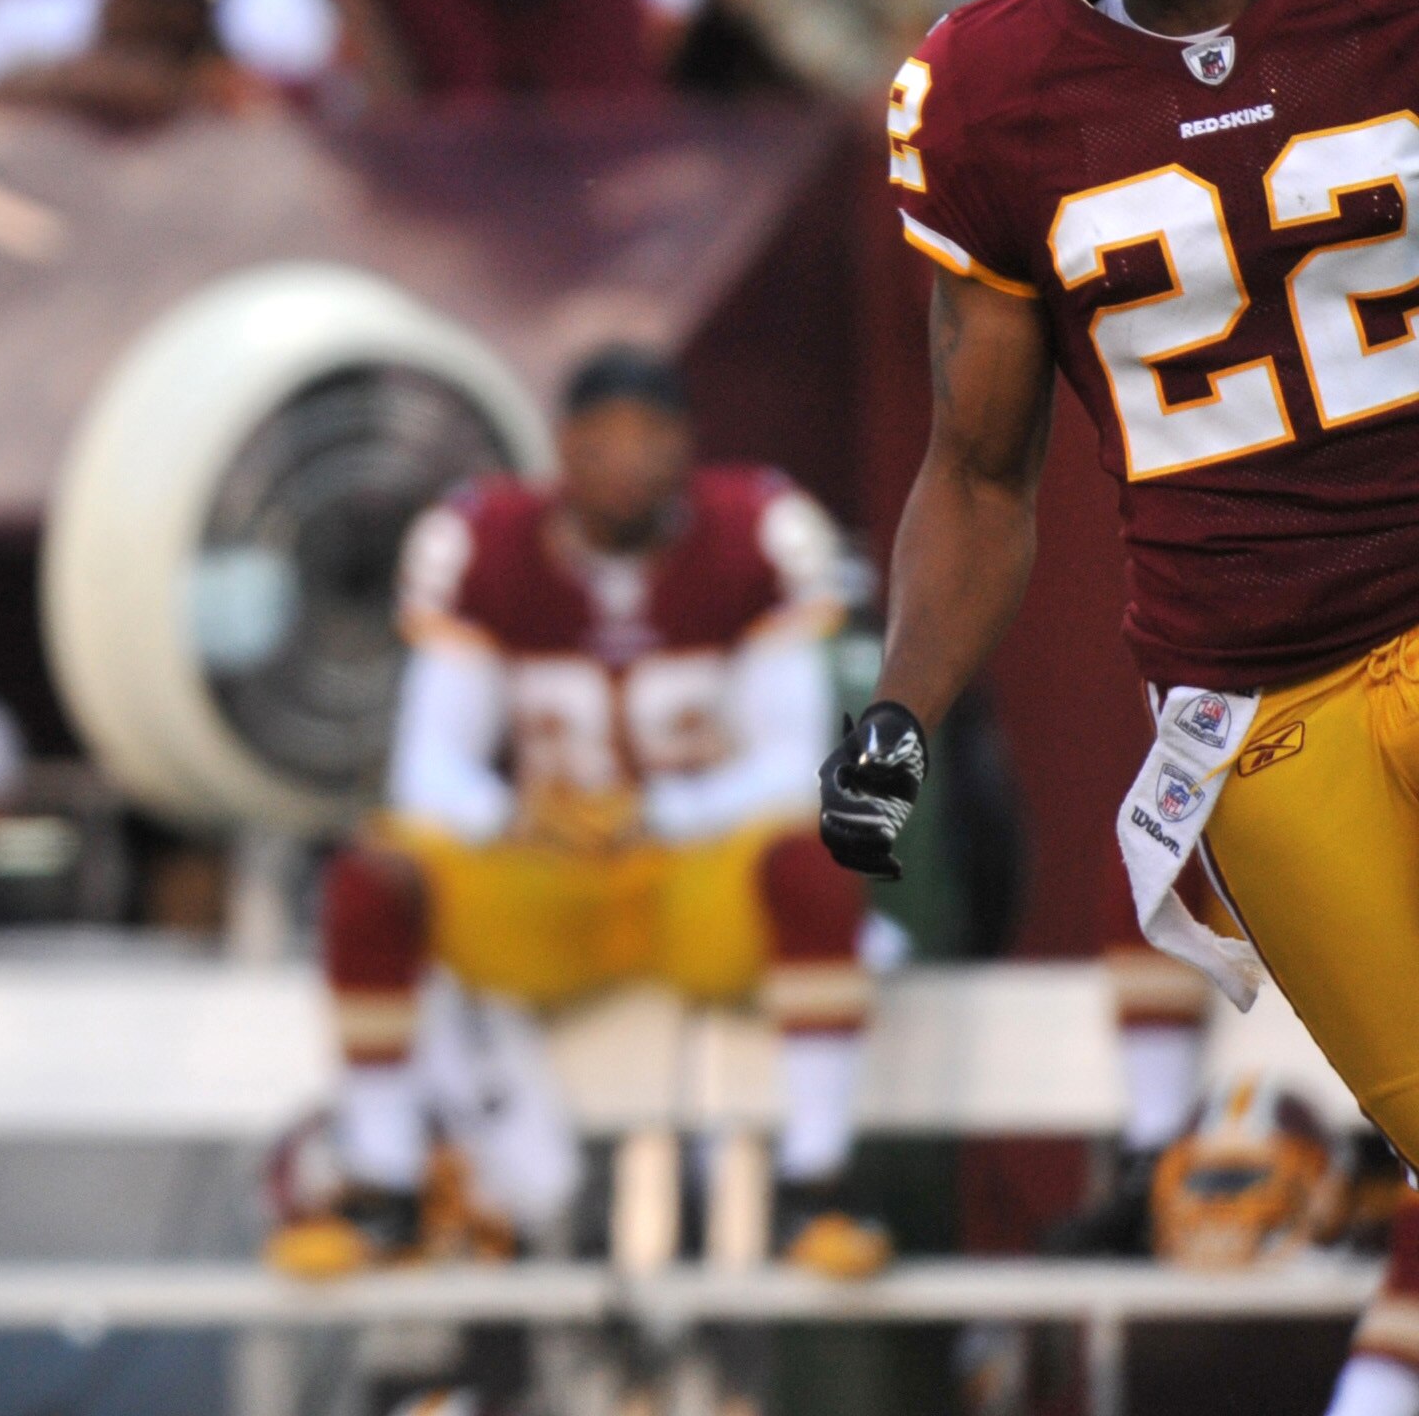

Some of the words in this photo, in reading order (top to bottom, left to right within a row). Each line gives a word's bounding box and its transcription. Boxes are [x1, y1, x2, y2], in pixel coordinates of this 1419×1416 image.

[1180, 103, 1275, 139] REDSKINS
[1047, 108, 1419, 483] 22
[1130, 805, 1181, 858] Wilson
